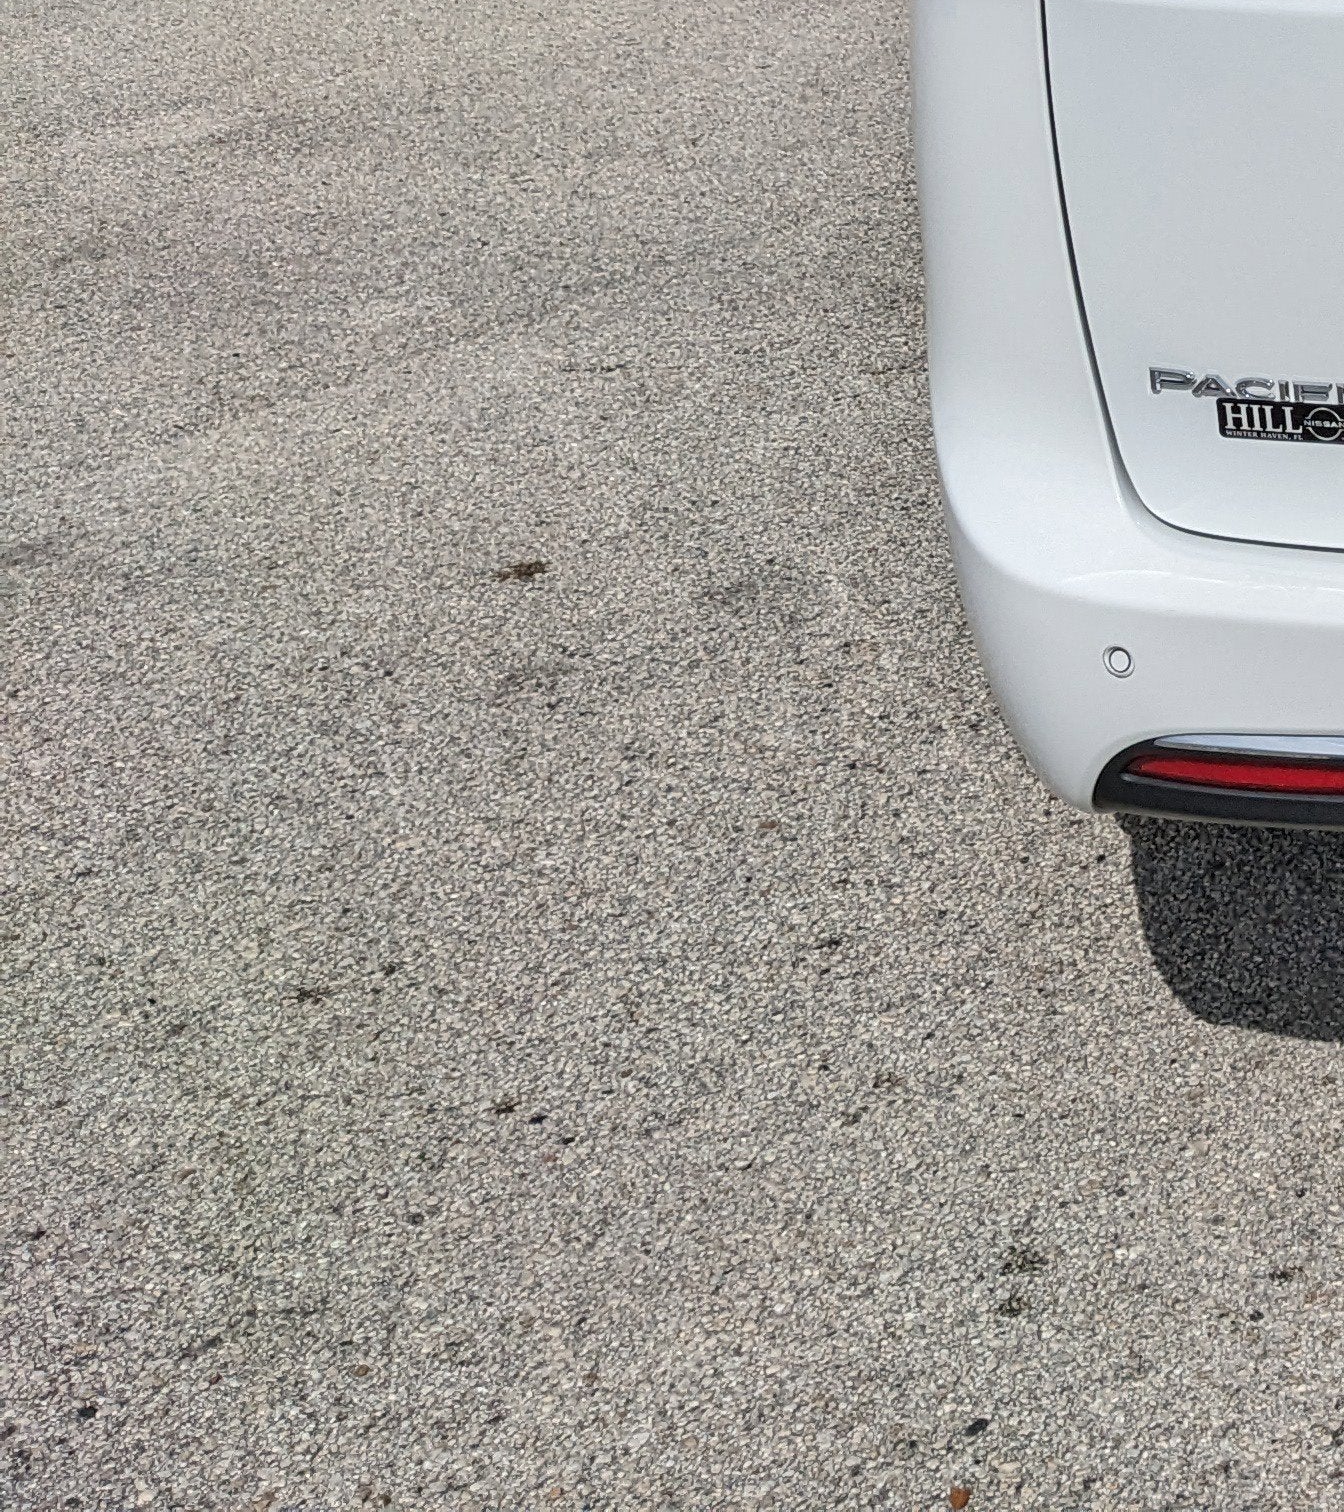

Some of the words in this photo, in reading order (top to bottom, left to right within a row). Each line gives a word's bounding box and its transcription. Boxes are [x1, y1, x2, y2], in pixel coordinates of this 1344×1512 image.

[1222, 402, 1304, 434] HILL
[1225, 429, 1259, 439] WINTER
[1260, 432, 1292, 441] HAVEN,
